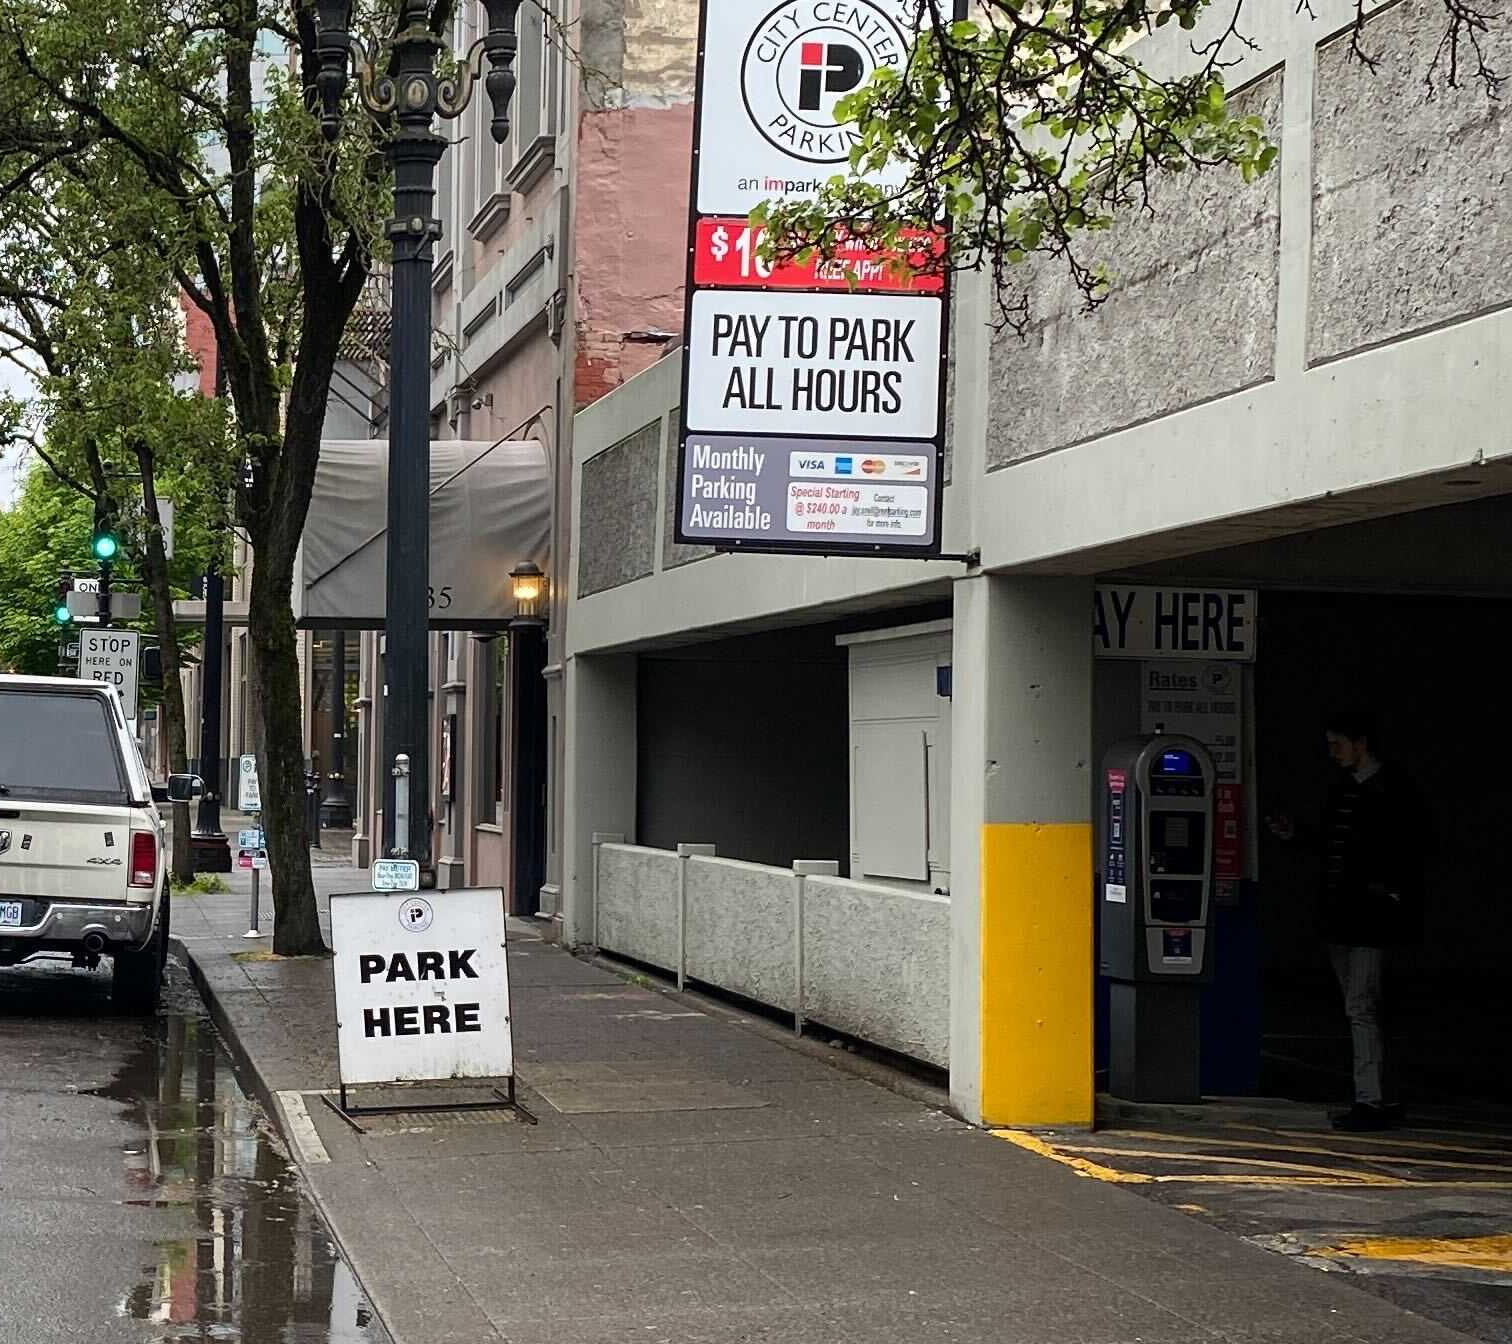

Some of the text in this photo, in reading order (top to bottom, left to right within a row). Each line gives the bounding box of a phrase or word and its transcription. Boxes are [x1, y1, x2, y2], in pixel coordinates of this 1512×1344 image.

[756, 1, 899, 67] CITY CENTER
[768, 113, 865, 154] PARKIN
[737, 177, 760, 191] an
[763, 175, 822, 195] impark
[711, 313, 916, 363] PAY TO PARK
[721, 365, 903, 415] ALL HOURS
[692, 444, 766, 476] Monthly
[798, 459, 825, 471] VISA
[691, 474, 757, 505] Parking
[790, 485, 861, 502] Special Starting
[689, 503, 772, 531] Available
[806, 518, 836, 531] month
[1094, 590, 1245, 652] AY HERE
[88, 637, 131, 653] STOP
[85, 656, 133, 667] HERE ON
[1149, 670, 1197, 688] Rates
[359, 948, 481, 984] PARK
[363, 1002, 482, 1039] HERE
